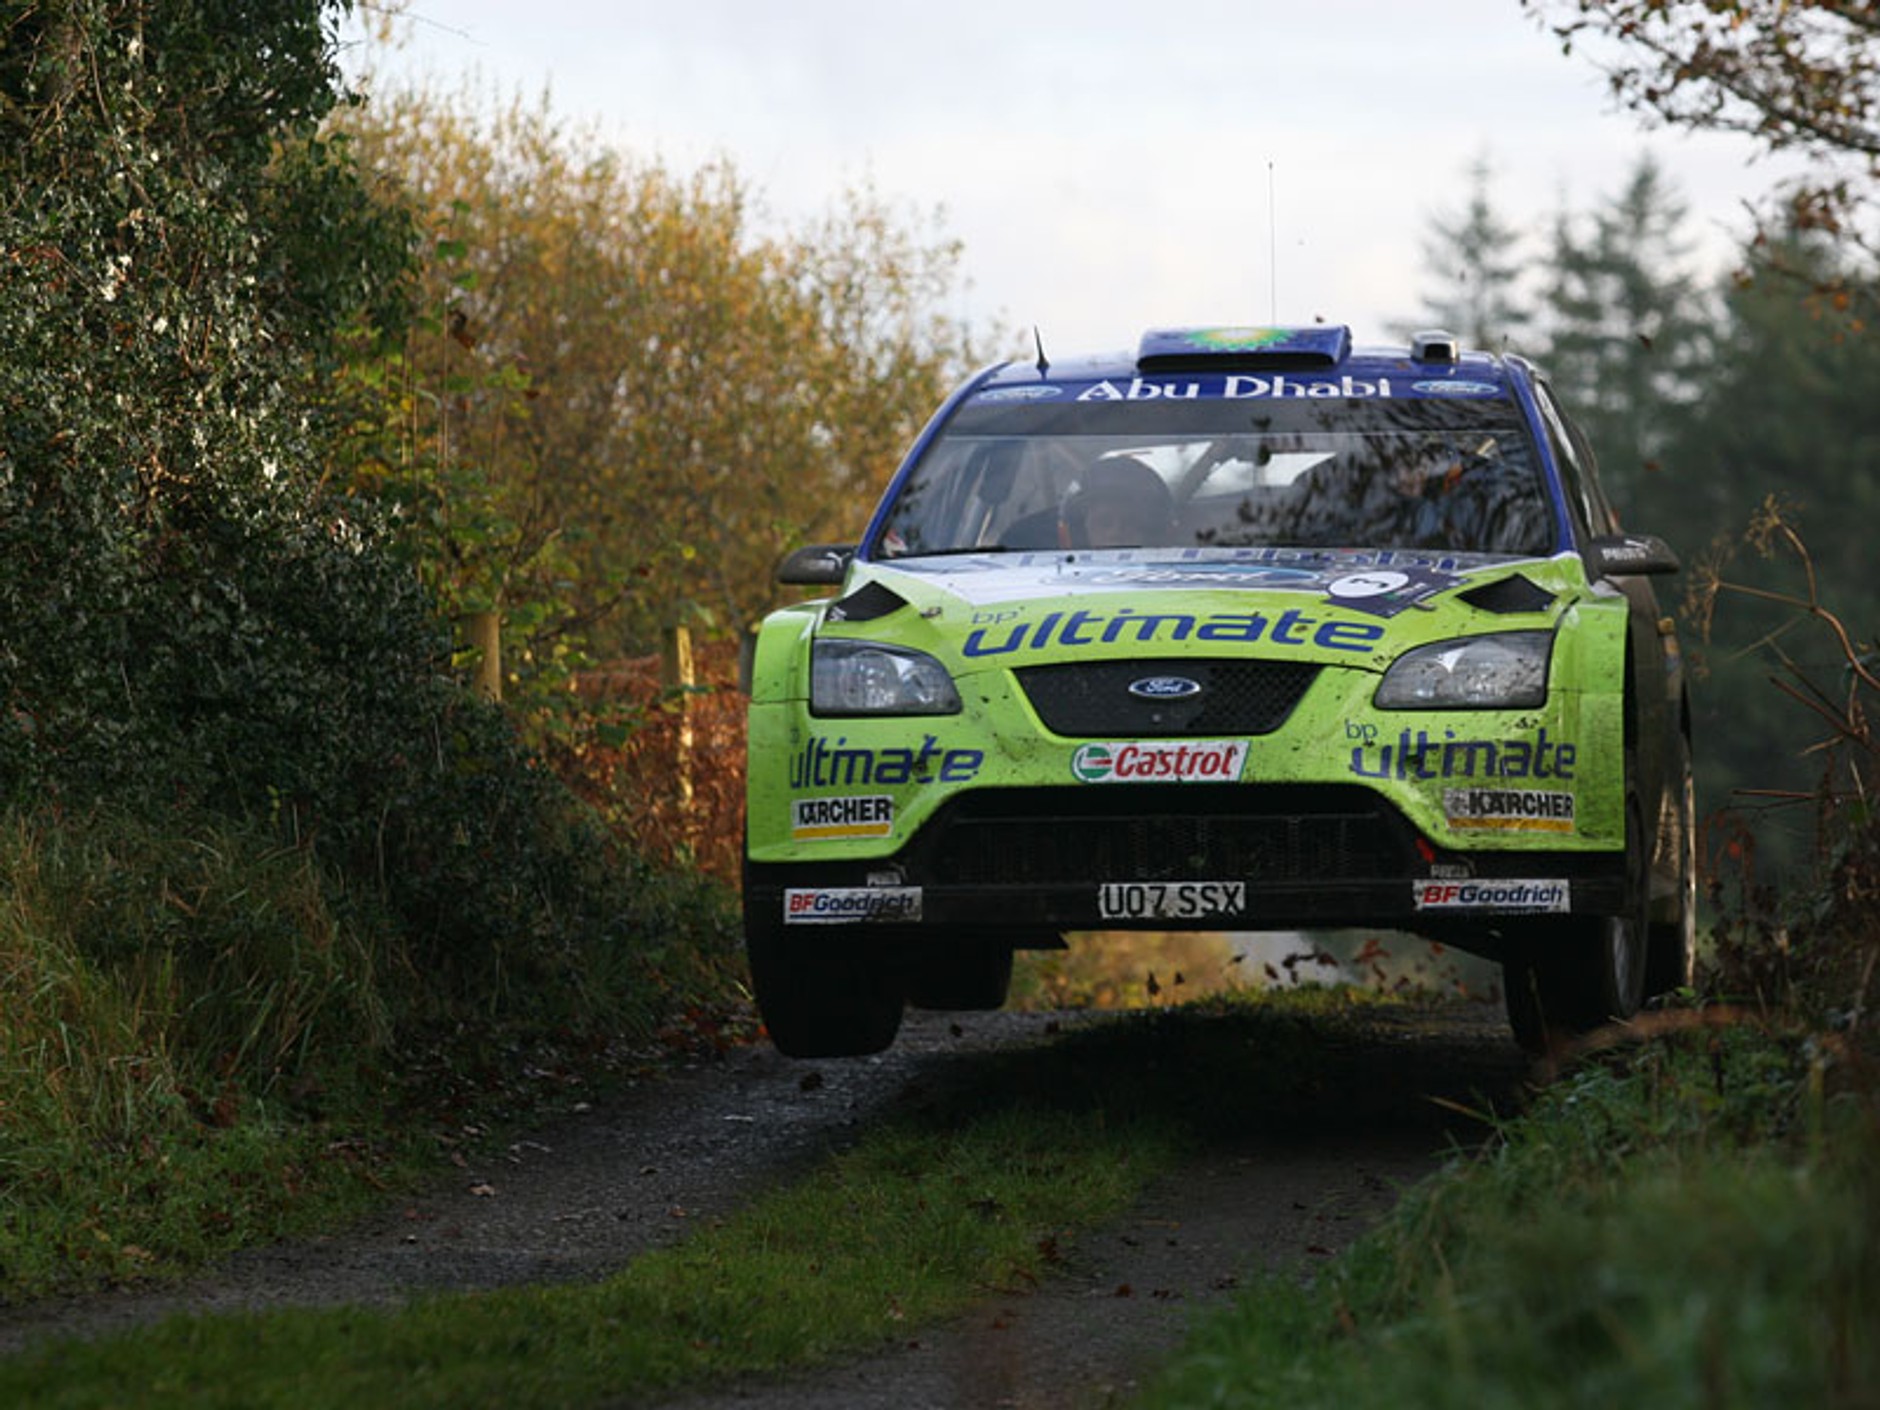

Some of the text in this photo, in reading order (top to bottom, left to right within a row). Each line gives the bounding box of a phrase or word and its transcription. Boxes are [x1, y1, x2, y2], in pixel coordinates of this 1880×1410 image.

[1076, 377, 1200, 401] Abu
[1224, 375, 1390, 398] Dhabi
[962, 609, 1385, 658] ultimate
[1345, 718, 1378, 740] bp
[789, 735, 985, 789] ultimate
[1114, 745, 1238, 777] Castrol
[1350, 727, 1577, 780] ultimate
[1178, 885, 1242, 916] SSX
[1423, 885, 1564, 904] BFGoodrich
